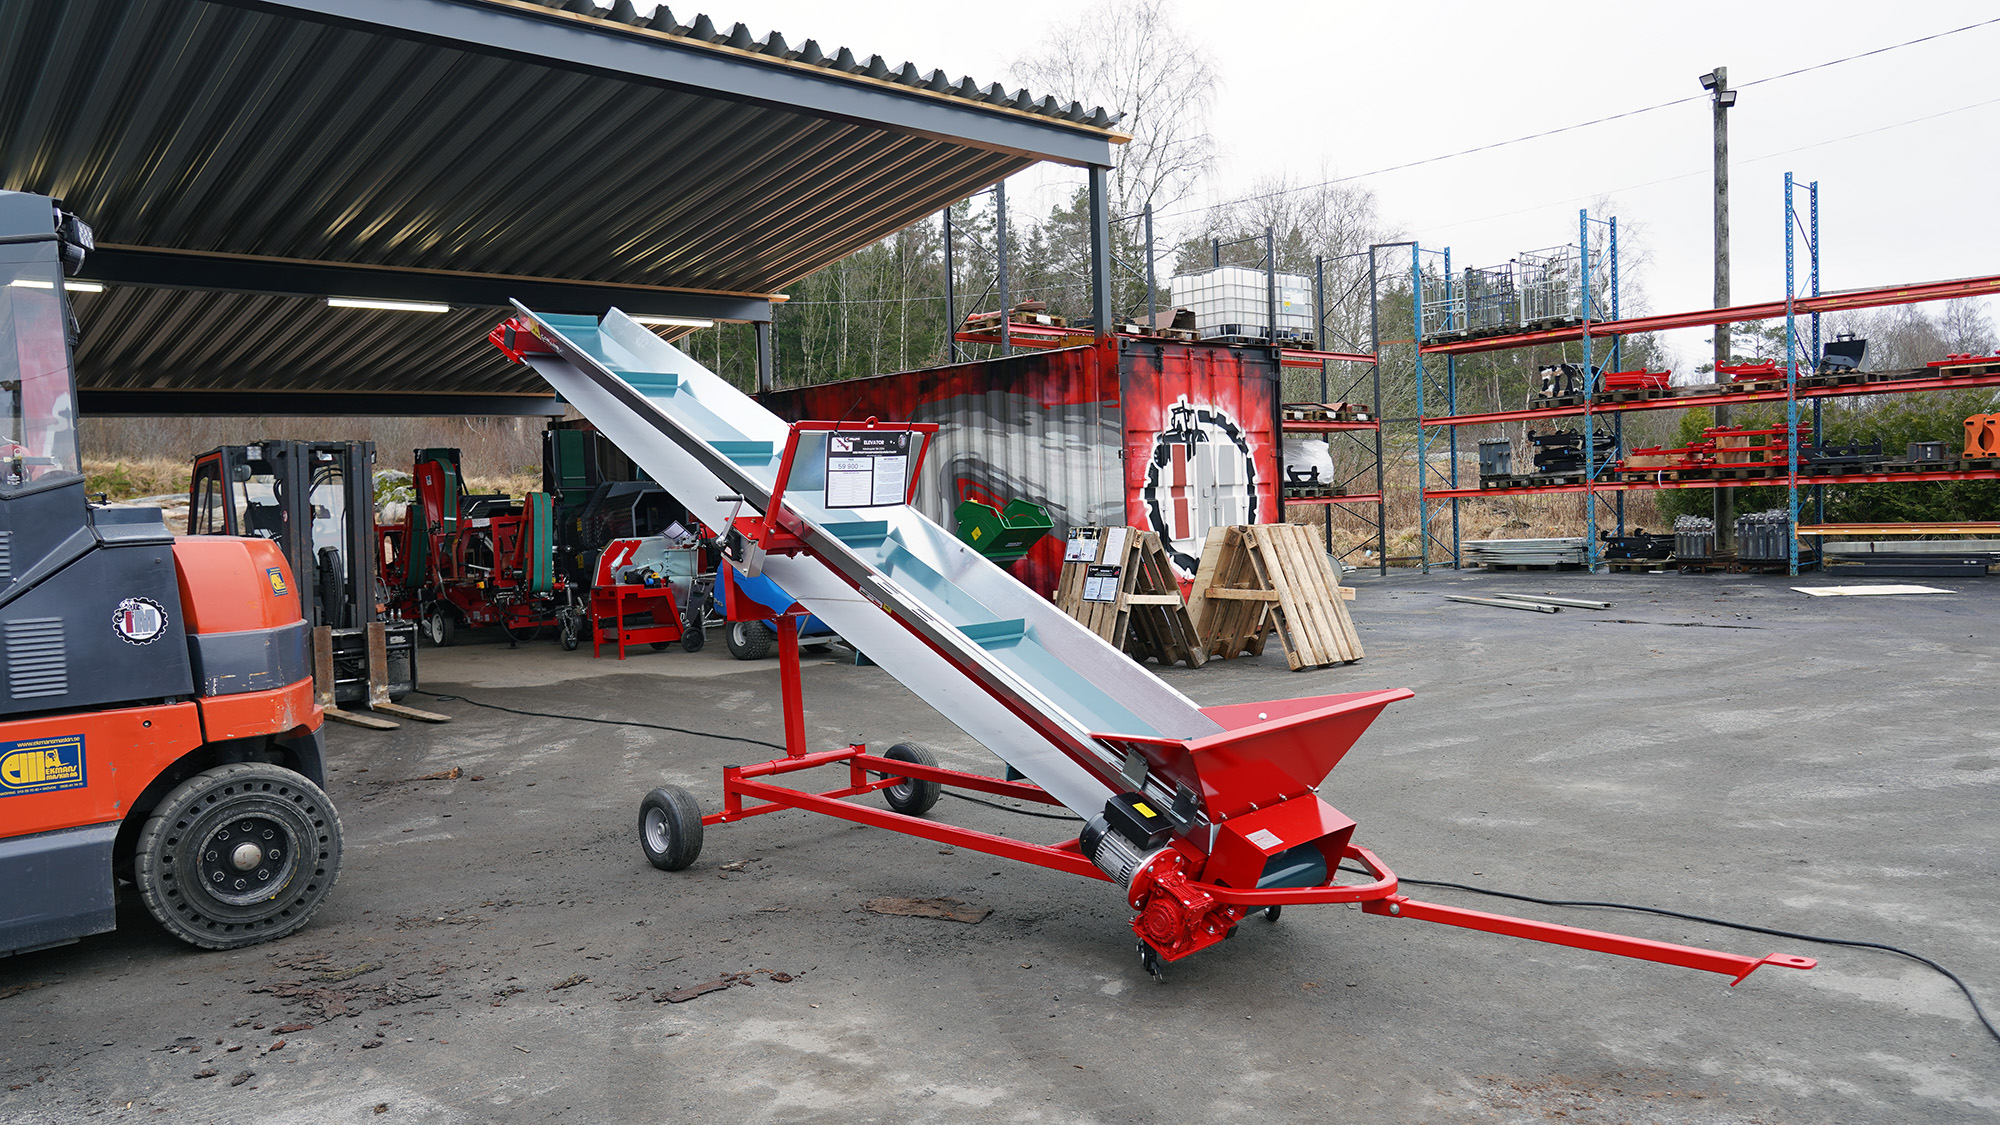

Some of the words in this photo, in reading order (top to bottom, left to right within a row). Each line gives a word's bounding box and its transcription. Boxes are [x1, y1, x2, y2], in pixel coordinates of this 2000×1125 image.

[125, 609, 156, 633] IM
[17, 736, 80, 747] www.ekmansmaskin.se
[46, 765, 77, 774] EKMANS
